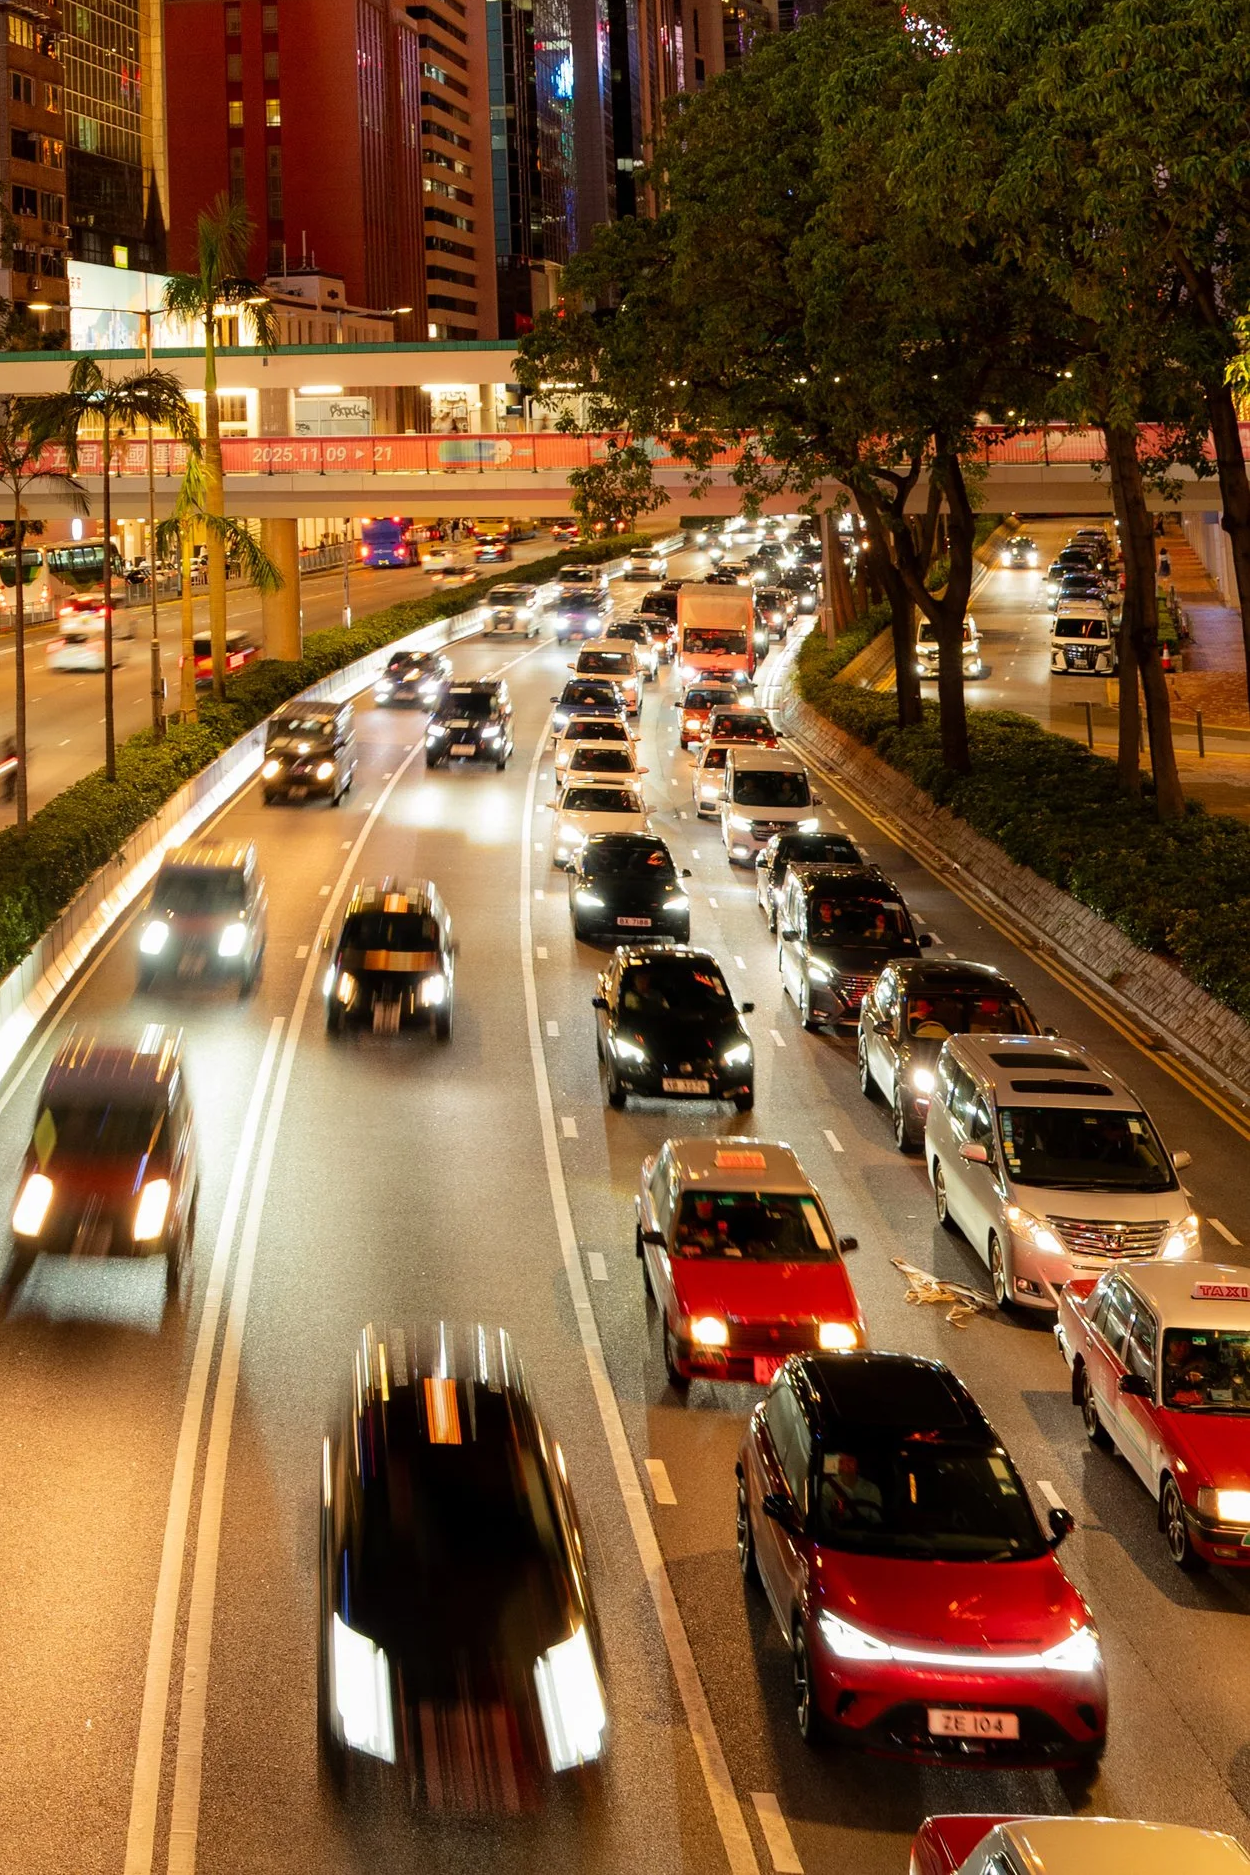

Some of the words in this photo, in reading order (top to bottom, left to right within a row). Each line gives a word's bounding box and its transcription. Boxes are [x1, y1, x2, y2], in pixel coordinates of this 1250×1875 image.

[252, 446, 348, 463] 2025.11.09
[372, 446, 393, 461] 21
[1199, 1285, 1248, 1298] TAXI
[942, 1713, 967, 1732] ZE
[973, 1715, 1004, 1734] 104
